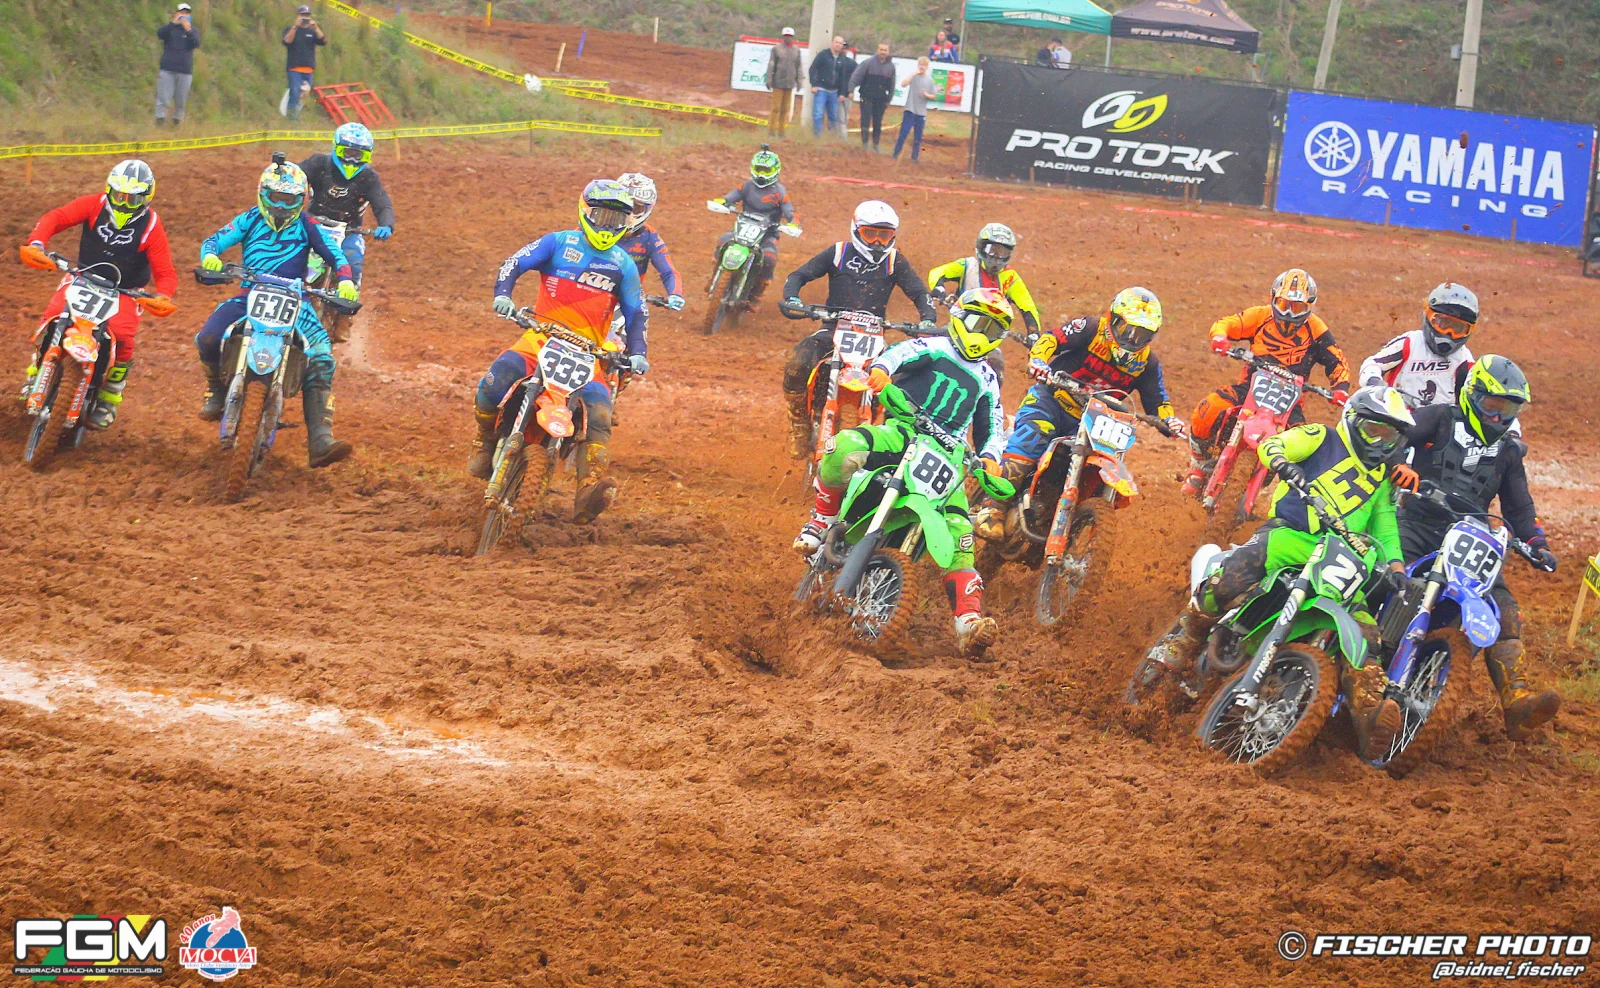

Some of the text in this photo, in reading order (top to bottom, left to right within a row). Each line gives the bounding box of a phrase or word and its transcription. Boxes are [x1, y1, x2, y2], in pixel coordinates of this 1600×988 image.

[1005, 129, 1234, 174] PRO TORK
[1366, 129, 1565, 201] YAMAHA
[1034, 160, 1205, 184] RACING DEVELOPMENT
[1321, 180, 1549, 218] RACING
[577, 271, 617, 292] KTM
[71, 289, 114, 320] 31
[250, 293, 299, 324] 636
[840, 332, 876, 358] 541
[1091, 341, 1109, 357] 180
[543, 350, 591, 389] 333
[1411, 360, 1451, 371] IMS
[1252, 376, 1298, 415] 222
[1091, 414, 1133, 450] 86
[1467, 446, 1500, 458] IMS
[912, 451, 954, 495] 88
[1447, 533, 1500, 584] 932
